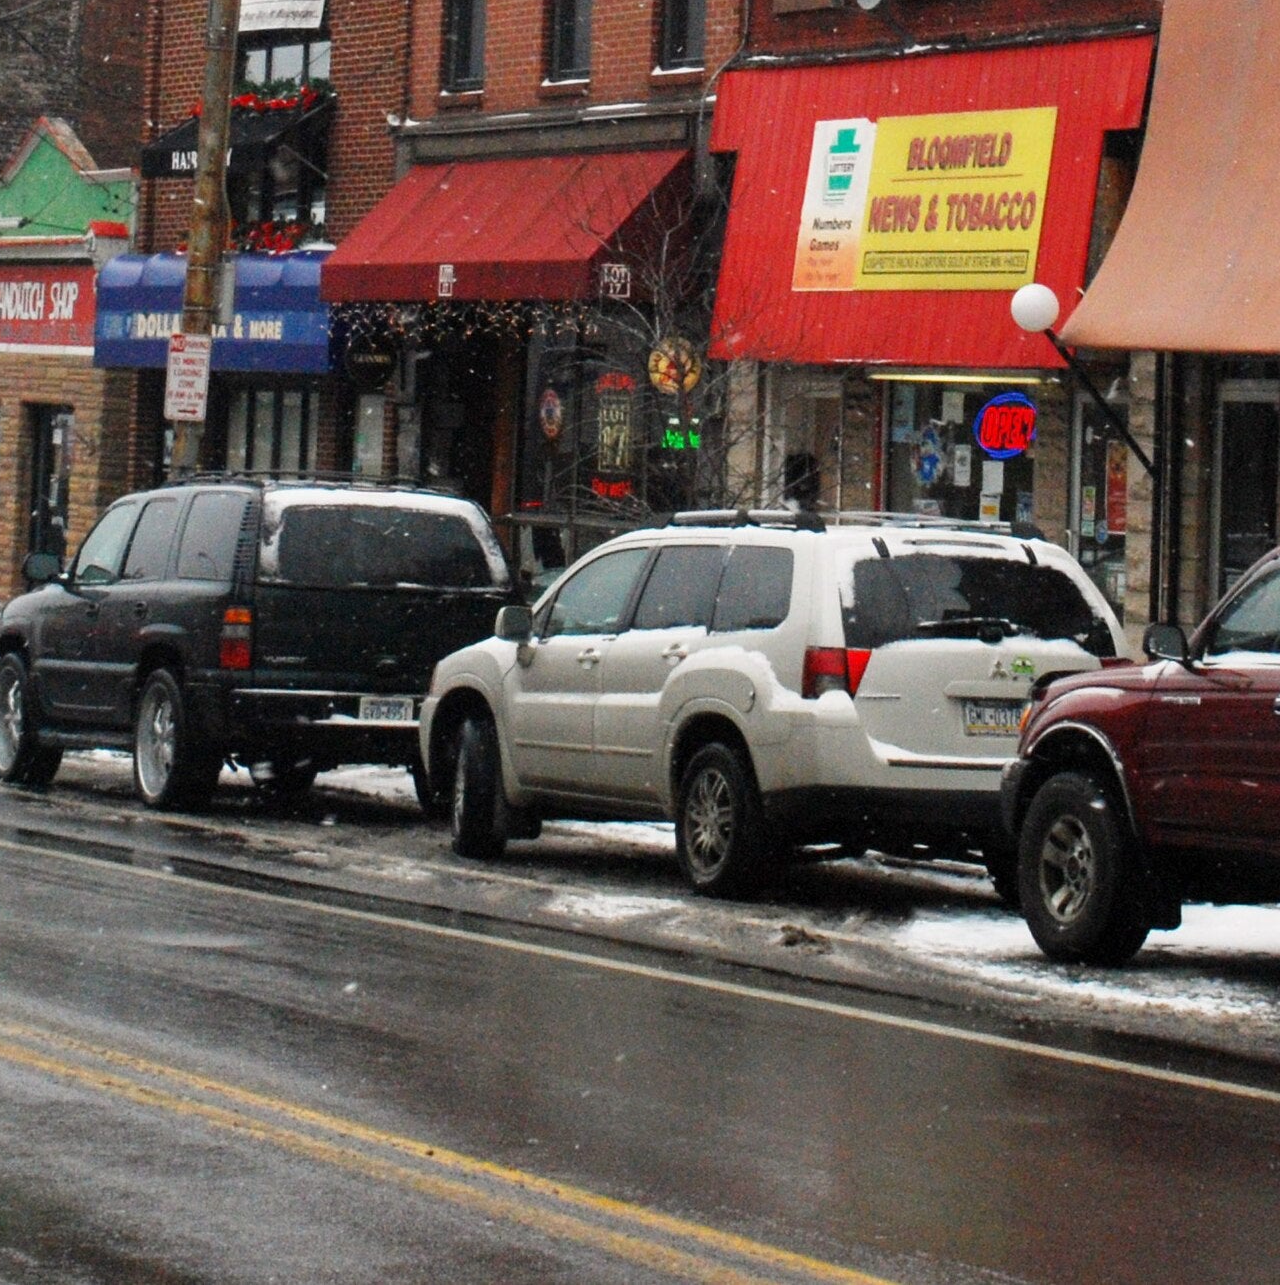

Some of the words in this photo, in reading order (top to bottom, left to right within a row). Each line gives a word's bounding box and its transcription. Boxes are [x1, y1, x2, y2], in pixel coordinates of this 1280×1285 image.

[829, 163, 855, 174] LOTTERY
[906, 132, 1013, 172] BLOOMFIELD
[812, 217, 853, 231] Numbers
[868, 195, 923, 233] NEWS
[924, 194, 940, 232] &
[946, 191, 1037, 233] TOBACCO
[809, 238, 841, 252] Games
[48, 281, 80, 321] SHOP
[233, 314, 244, 339] &
[249, 320, 282, 341] MORE
[980, 405, 1036, 450] OPEN
